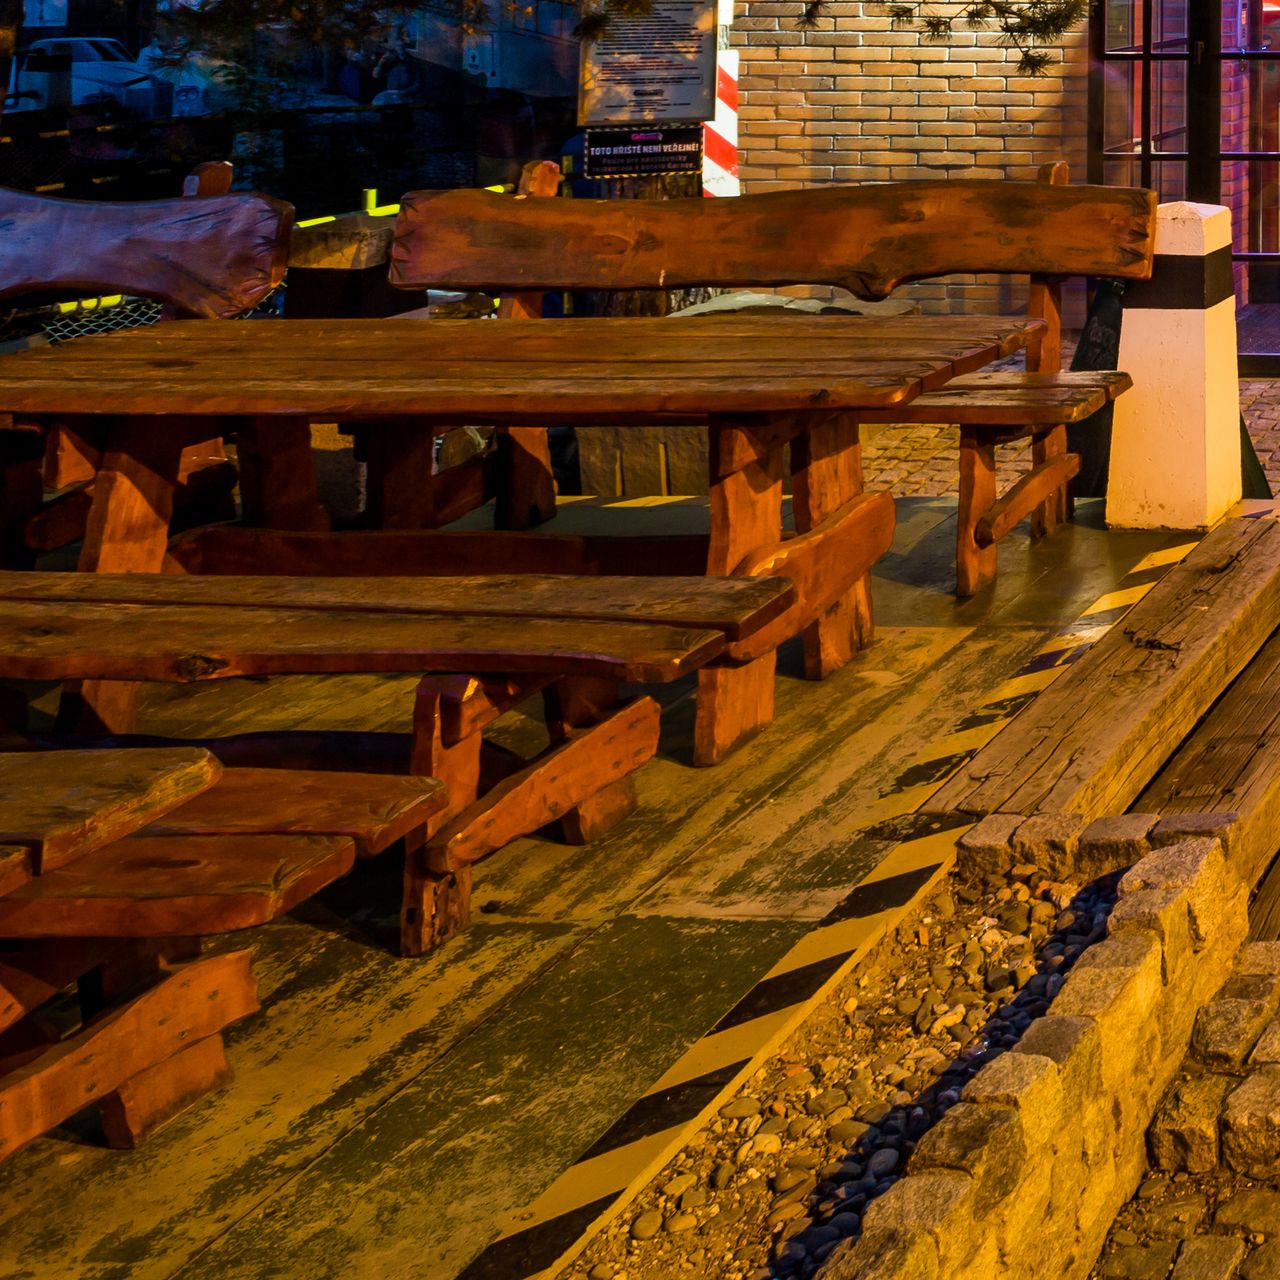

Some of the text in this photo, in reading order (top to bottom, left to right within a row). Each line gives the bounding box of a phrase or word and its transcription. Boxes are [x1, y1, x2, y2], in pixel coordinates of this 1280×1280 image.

[590, 146, 612, 156] TOTO
[642, 143, 662, 153] NENÍ
[663, 141, 699, 153] VEŘEJNÉ!
